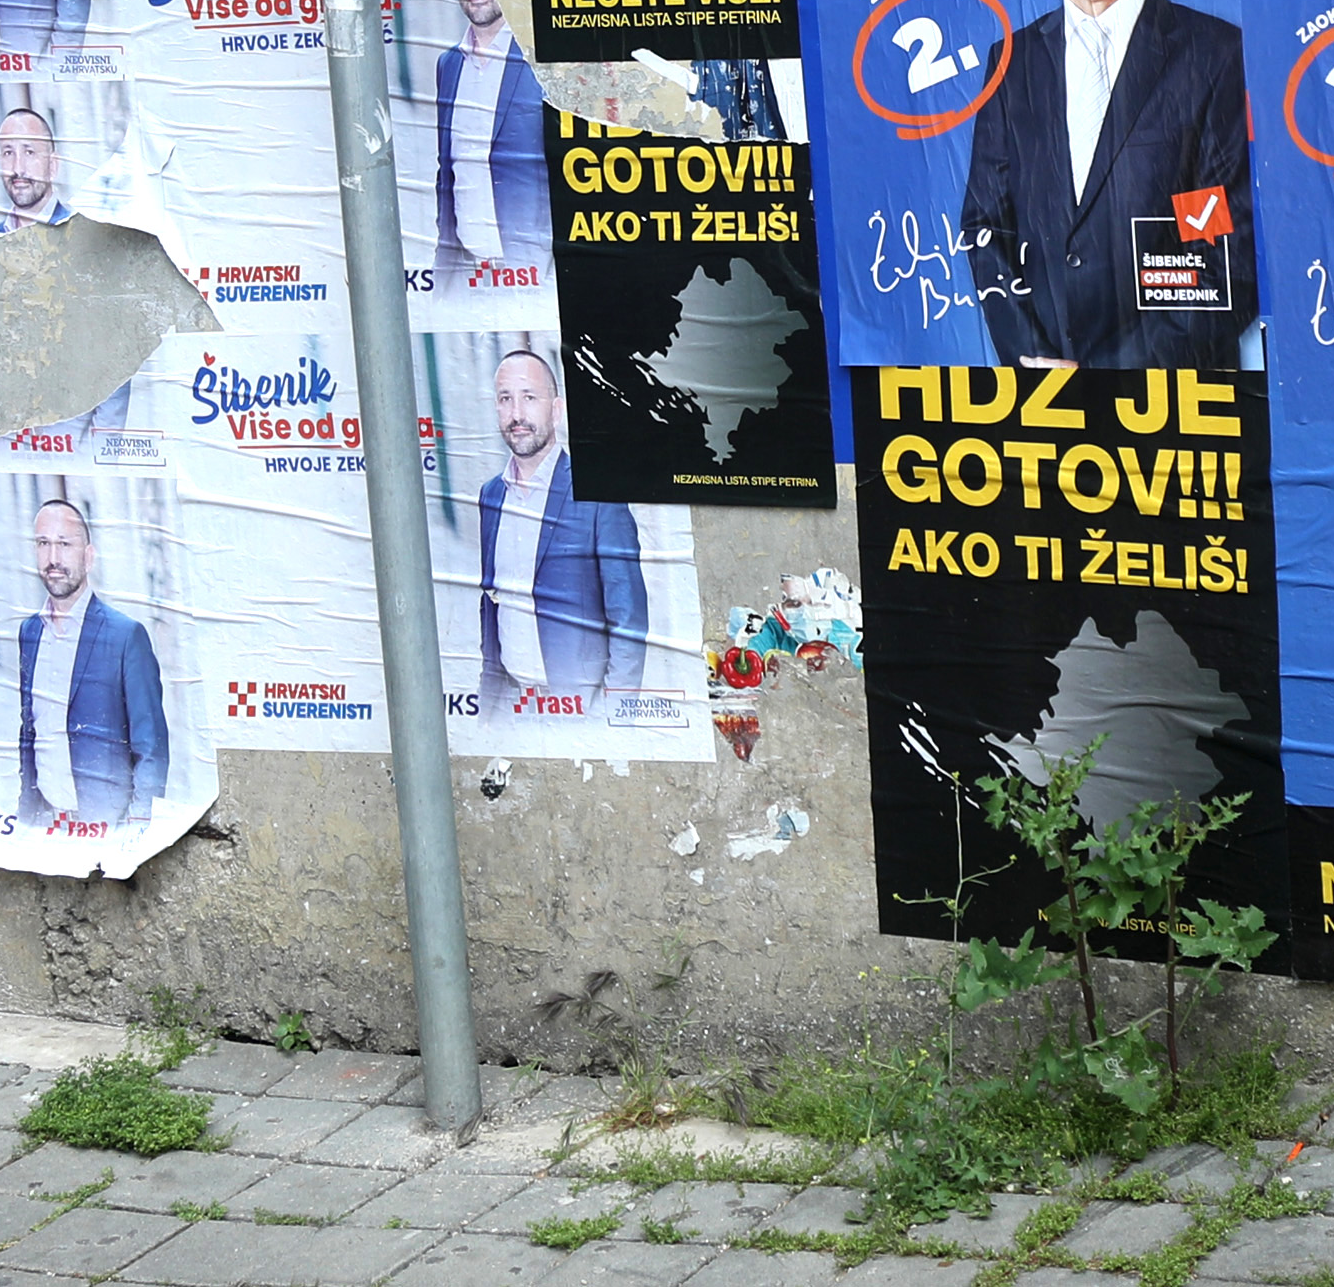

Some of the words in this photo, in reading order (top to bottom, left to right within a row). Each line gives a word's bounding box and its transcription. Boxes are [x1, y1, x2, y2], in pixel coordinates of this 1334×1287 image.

[552, 14, 629, 28] NEZAVISNA
[633, 13, 671, 27] LISTA
[675, 12, 715, 26] STIPE
[719, 10, 781, 25] PETRINA
[222, 34, 288, 52] HRVOJE
[65, 55, 110, 65] NEOVISNI
[891, 17, 980, 93] 2.
[59, 65, 73, 73] ZA
[74, 63, 117, 74] HRVATSKU
[562, 145, 795, 194] GOTOV!!!
[569, 211, 641, 242] AKO
[646, 212, 680, 242] TI
[691, 203, 799, 242] ŽELIŠ!
[1142, 253, 1206, 269] ŠIBENIČE,
[1144, 271, 1193, 285] OSTANI
[1145, 287, 1219, 302] POBJEDNIK
[878, 367, 1085, 429] HDZ
[1116, 368, 1241, 436] JE
[673, 474, 723, 486] NEZAVISNA
[725, 476, 749, 486] LISTA
[752, 476, 777, 487] STIPE
[779, 477, 818, 488] PETRINA
[882, 434, 1244, 521] GOTOV!!!
[888, 527, 1000, 578] AKO
[1015, 535, 1063, 581] TI
[1080, 528, 1248, 594] ŽELIŠ!
[264, 682, 345, 700] HRVATSKI
[262, 701, 372, 720] SUVERENISTI
[537, 695, 583, 714] rast
[620, 698, 672, 709] NEOVISNI
[615, 708, 627, 718] ZA
[629, 708, 681, 719] HRVATSKU
